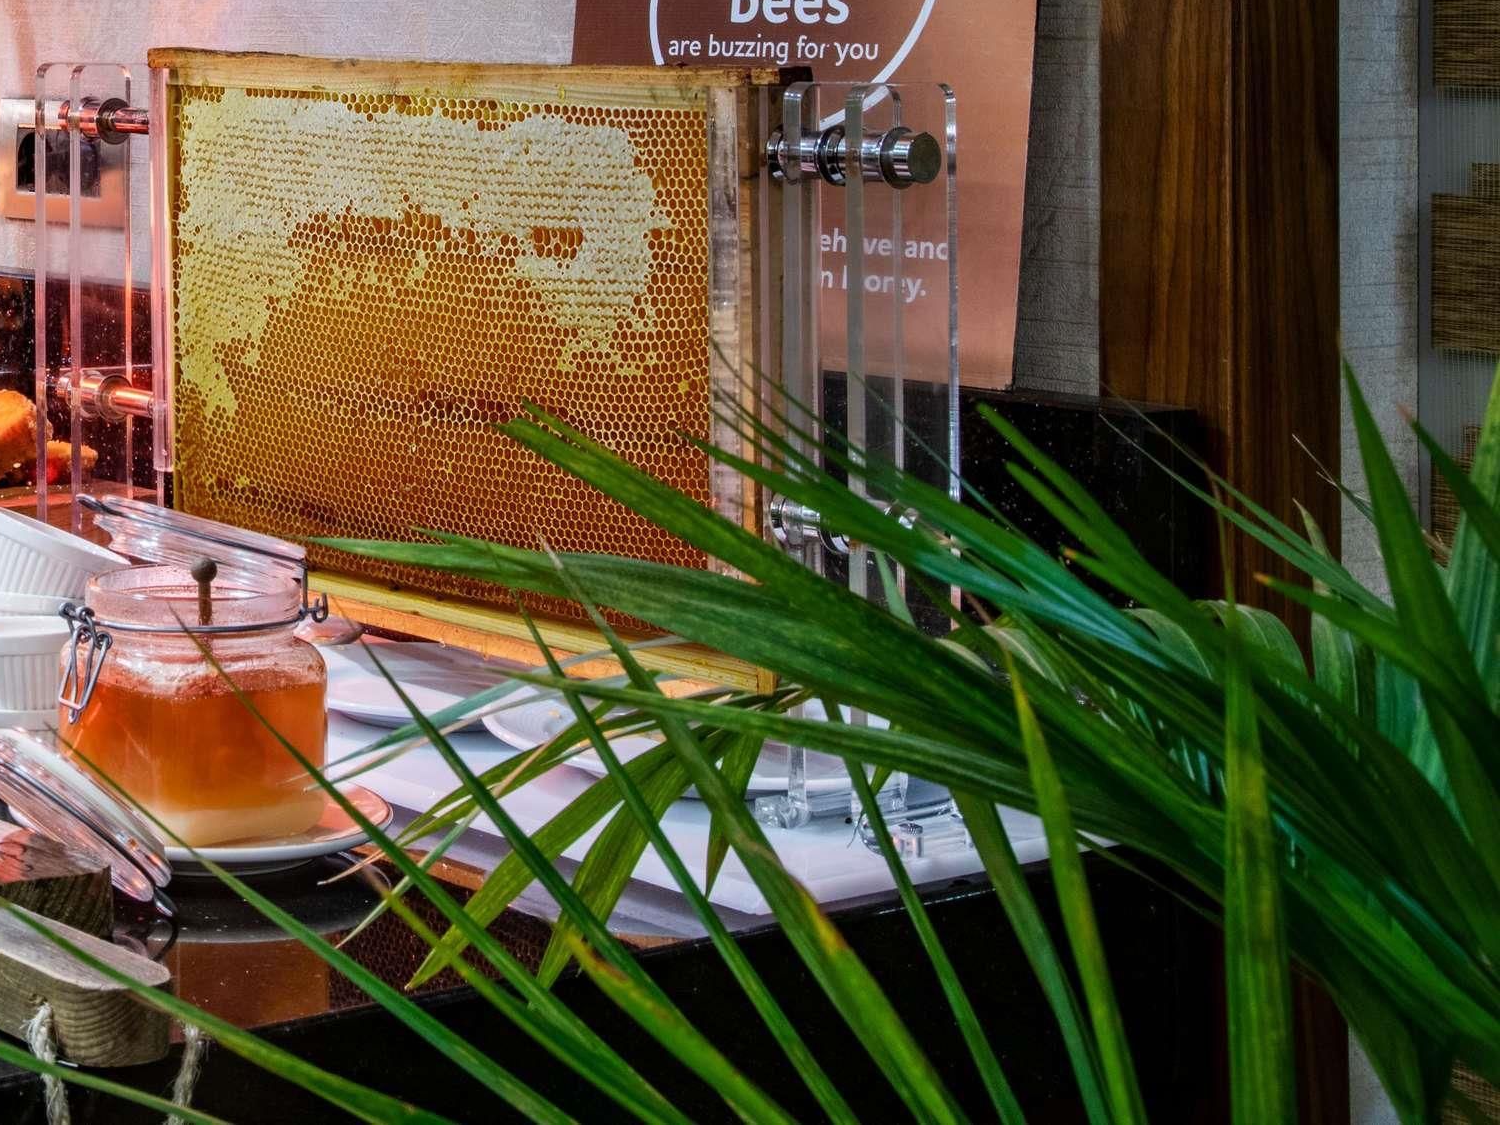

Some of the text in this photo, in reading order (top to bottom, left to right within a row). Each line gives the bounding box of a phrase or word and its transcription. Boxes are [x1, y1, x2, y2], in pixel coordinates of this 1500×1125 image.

[667, 34, 879, 65] are buzzing for you
